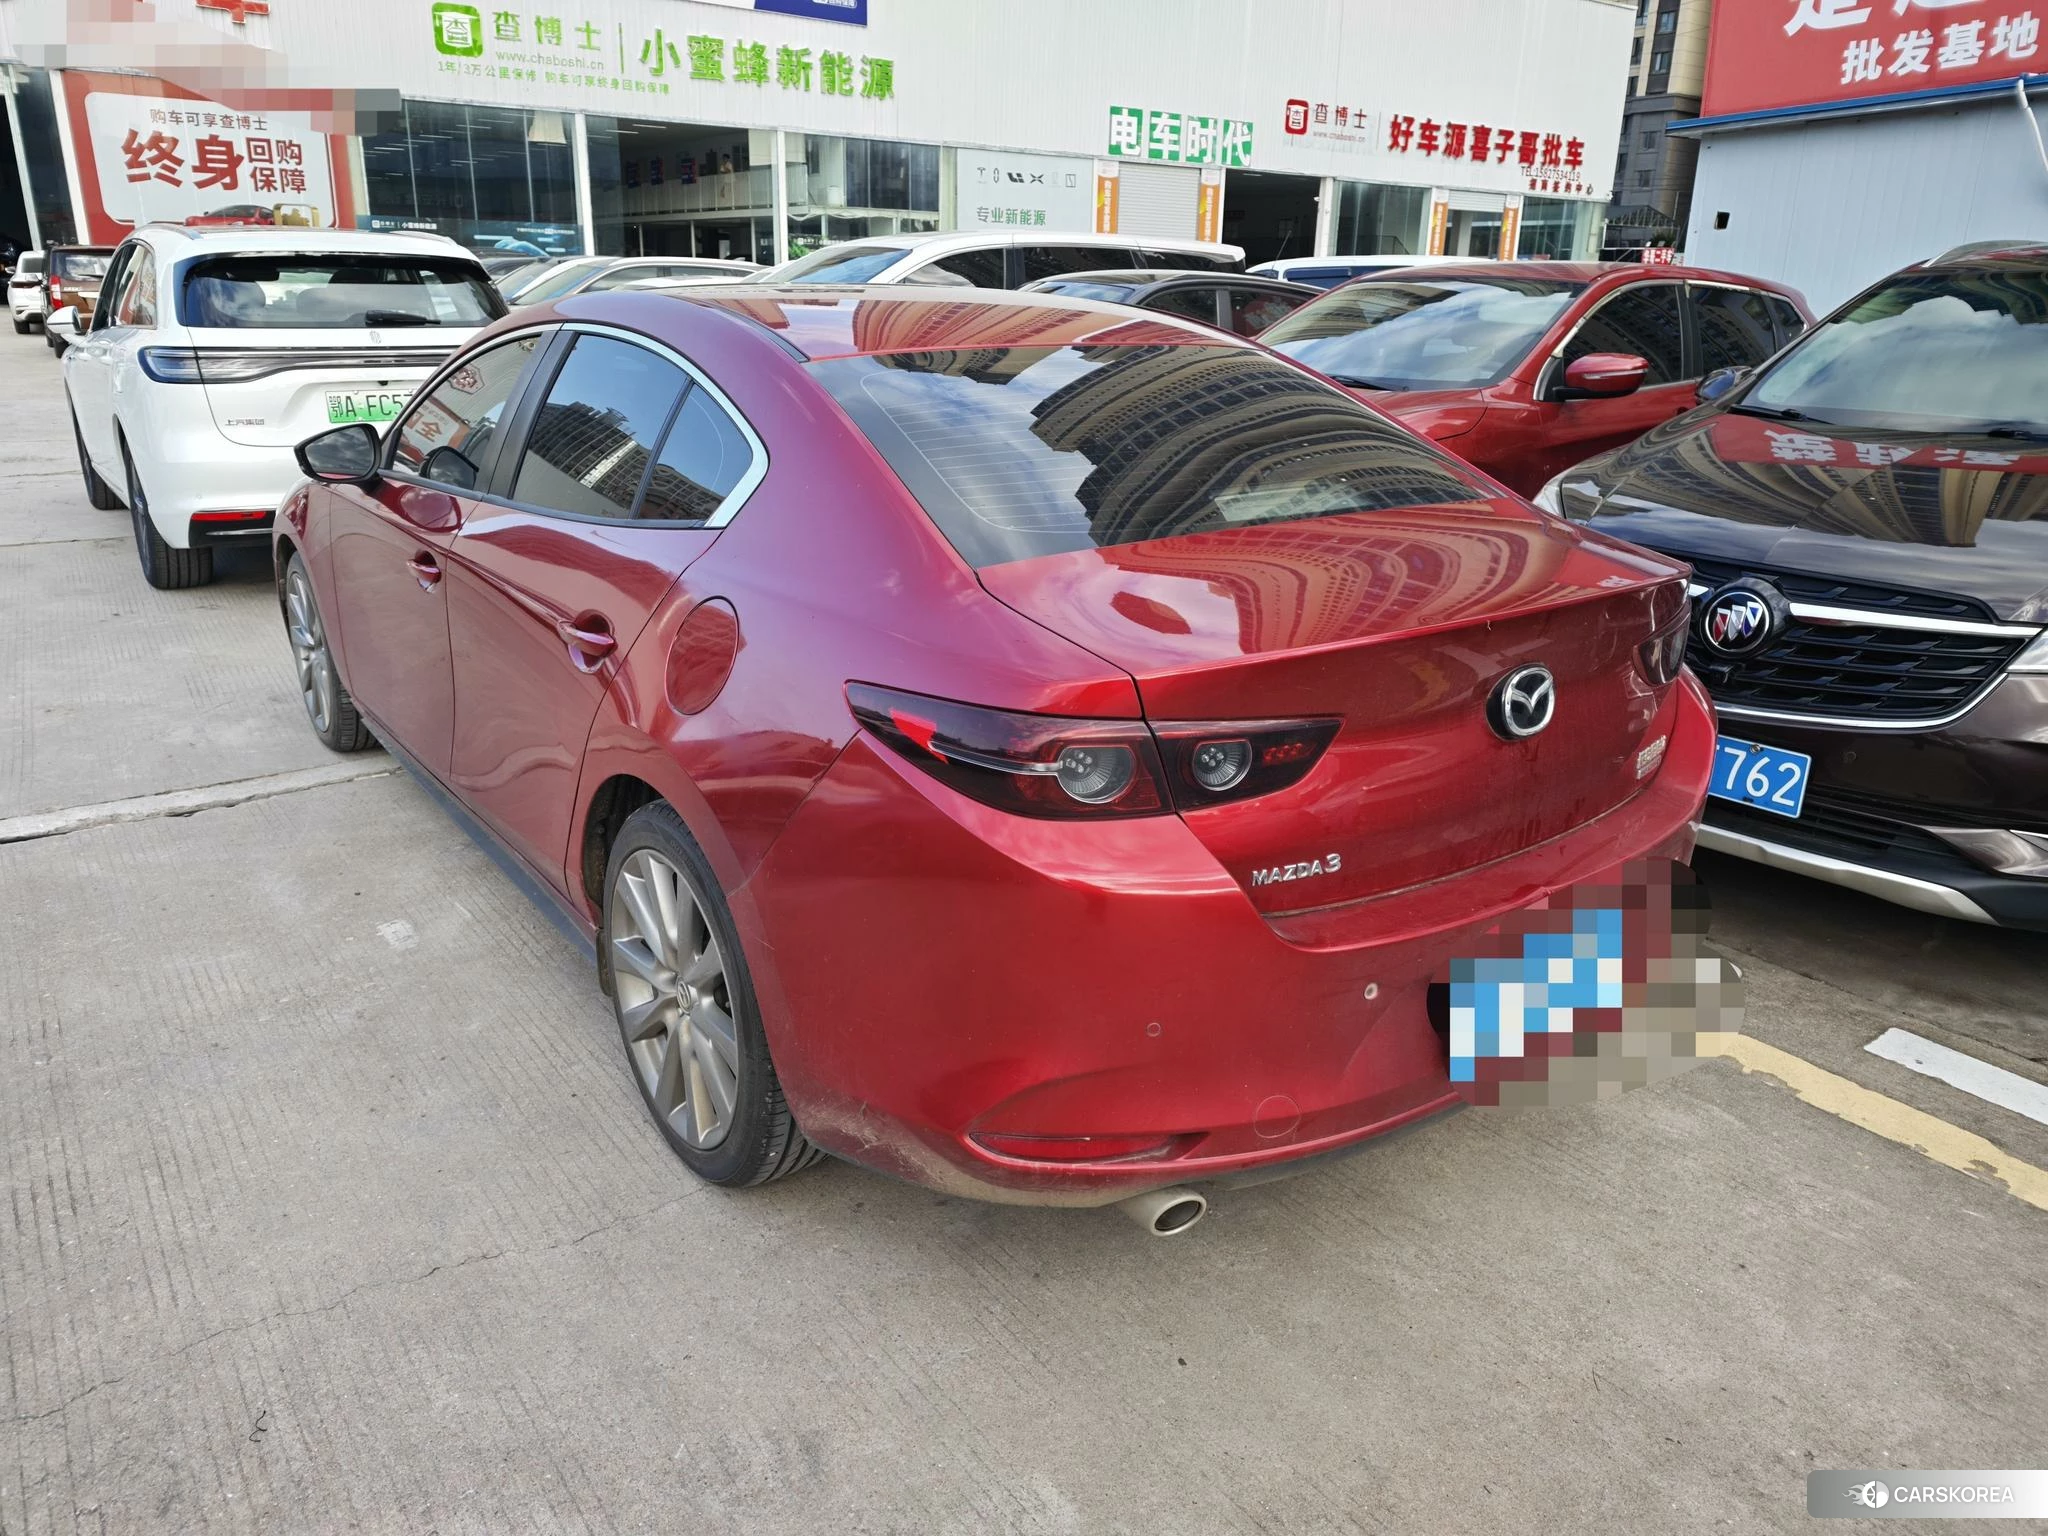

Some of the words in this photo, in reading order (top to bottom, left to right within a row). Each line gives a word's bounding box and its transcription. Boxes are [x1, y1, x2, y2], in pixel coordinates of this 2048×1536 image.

[492, 11, 601, 50] 查博士
[1840, 11, 2041, 85] 批发基地
[495, 51, 605, 71] www.chaboshi.cn
[638, 28, 896, 100] 小蜜蜂新能源
[150, 108, 268, 131] 购车可享查博士
[1314, 102, 1367, 129] 查博士
[246, 137, 302, 165] 回购
[1109, 108, 1253, 166] 电车时代
[1388, 114, 1585, 170] 好车源喜子哥批车
[121, 128, 244, 191] 终身
[250, 166, 306, 194] 保障
[977, 206, 1046, 226] 专业新能源
[1716, 745, 1801, 807] 762
